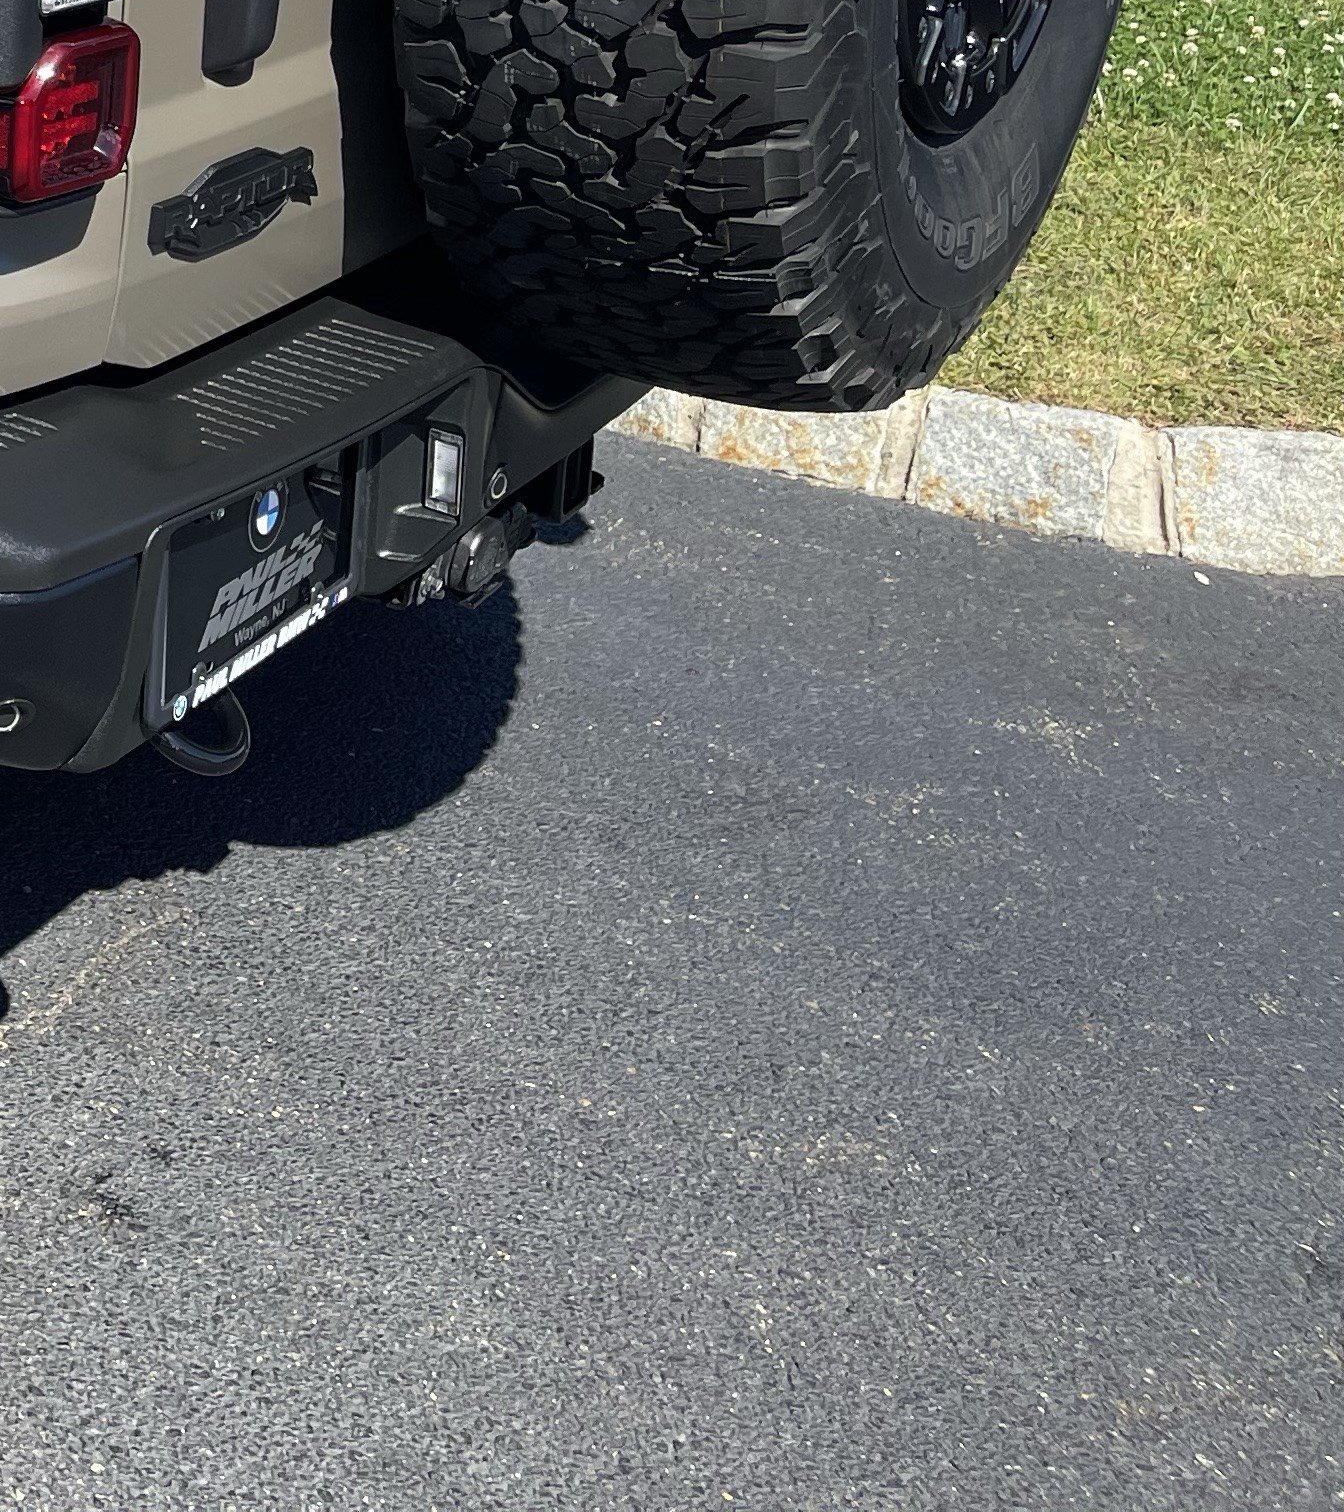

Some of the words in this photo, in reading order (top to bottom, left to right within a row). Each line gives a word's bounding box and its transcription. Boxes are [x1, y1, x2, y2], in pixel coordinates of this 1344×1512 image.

[162, 160, 318, 249] RAPTOR
[198, 543, 322, 653] MILLER
[210, 544, 298, 618] PAUL
[272, 598, 287, 621] NJ
[192, 666, 229, 708] PAUL
[229, 634, 277, 683] MILLER
